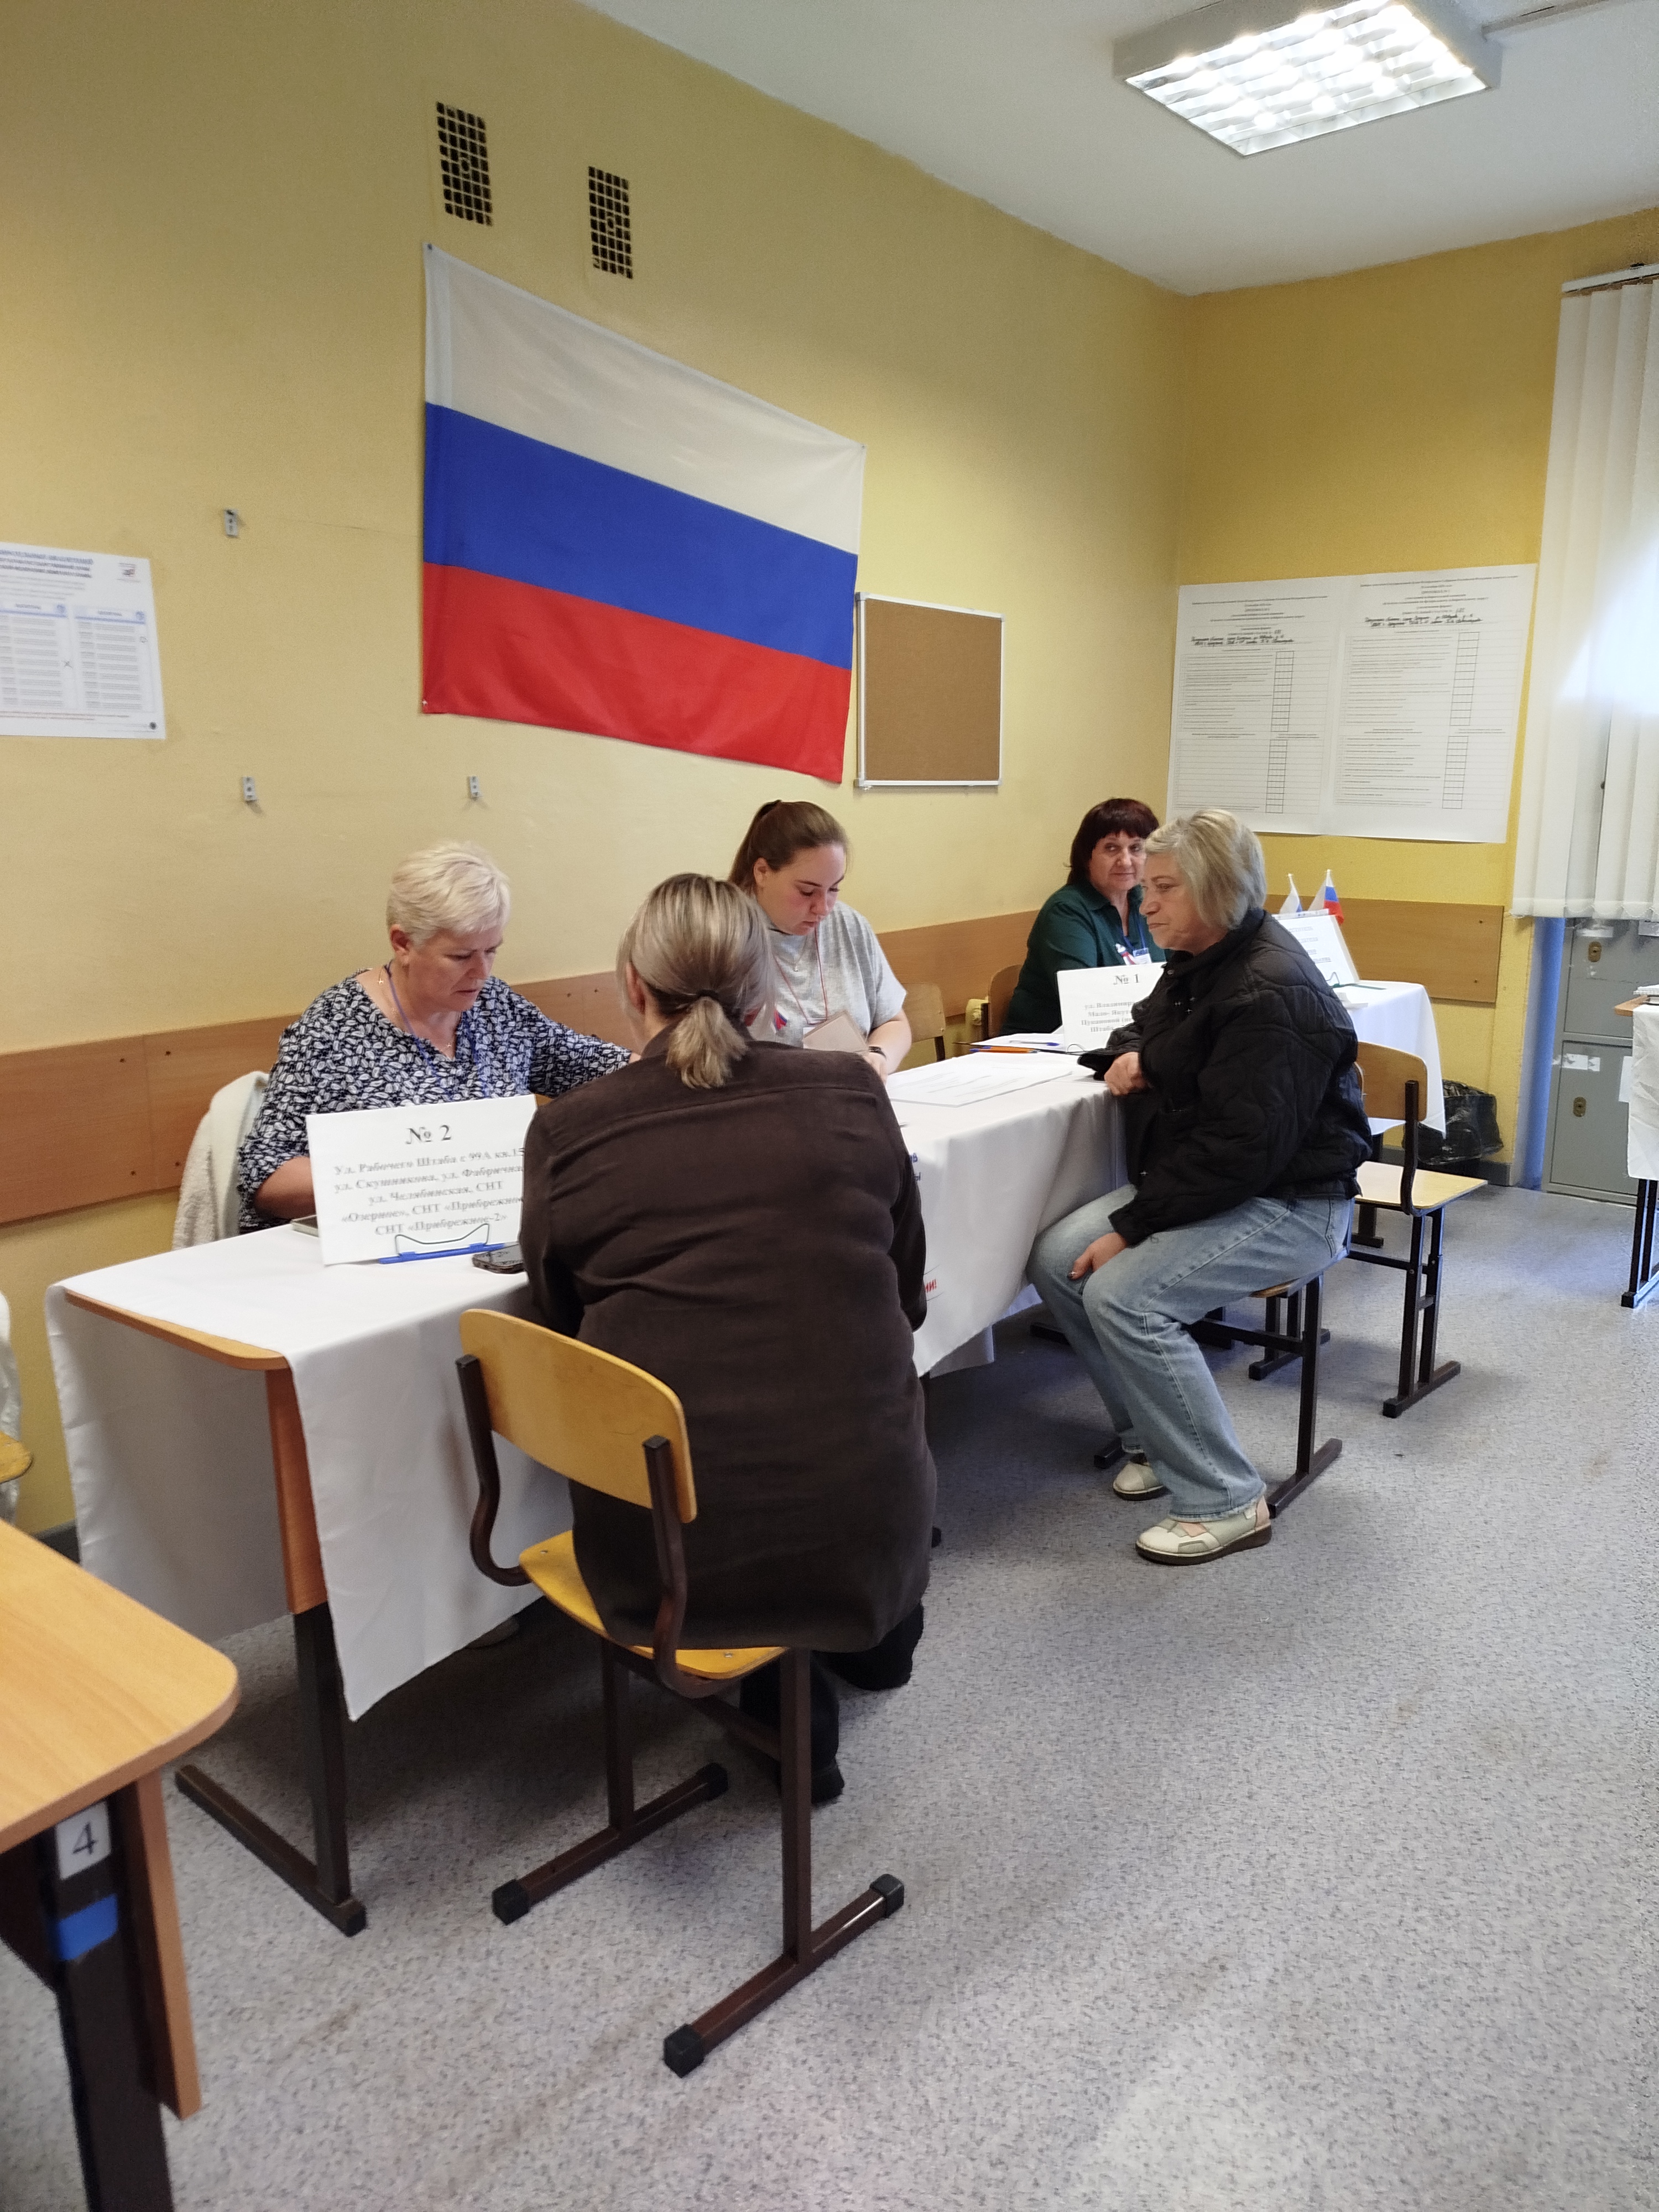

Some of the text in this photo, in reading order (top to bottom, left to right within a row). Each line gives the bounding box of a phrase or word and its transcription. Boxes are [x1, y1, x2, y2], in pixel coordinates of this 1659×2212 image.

[1134, 974, 1140, 983] 1
[406, 1124, 451, 1145] № 2
[335, 1165, 356, 1175] Ул.
[359, 1162, 413, 1173] Рабочего
[418, 1155, 456, 1167] Штаба
[469, 1151, 492, 1160] 99А
[334, 1183, 354, 1194] ул.
[442, 1172, 459, 1182] ул.
[462, 1165, 524, 1177] Фабрична
[369, 1196, 388, 1206] ул.
[476, 1181, 503, 1192] СНТ
[413, 1203, 440, 1215] СНТ
[375, 1224, 404, 1235] СНТ
[72, 1822, 97, 1855] 4
